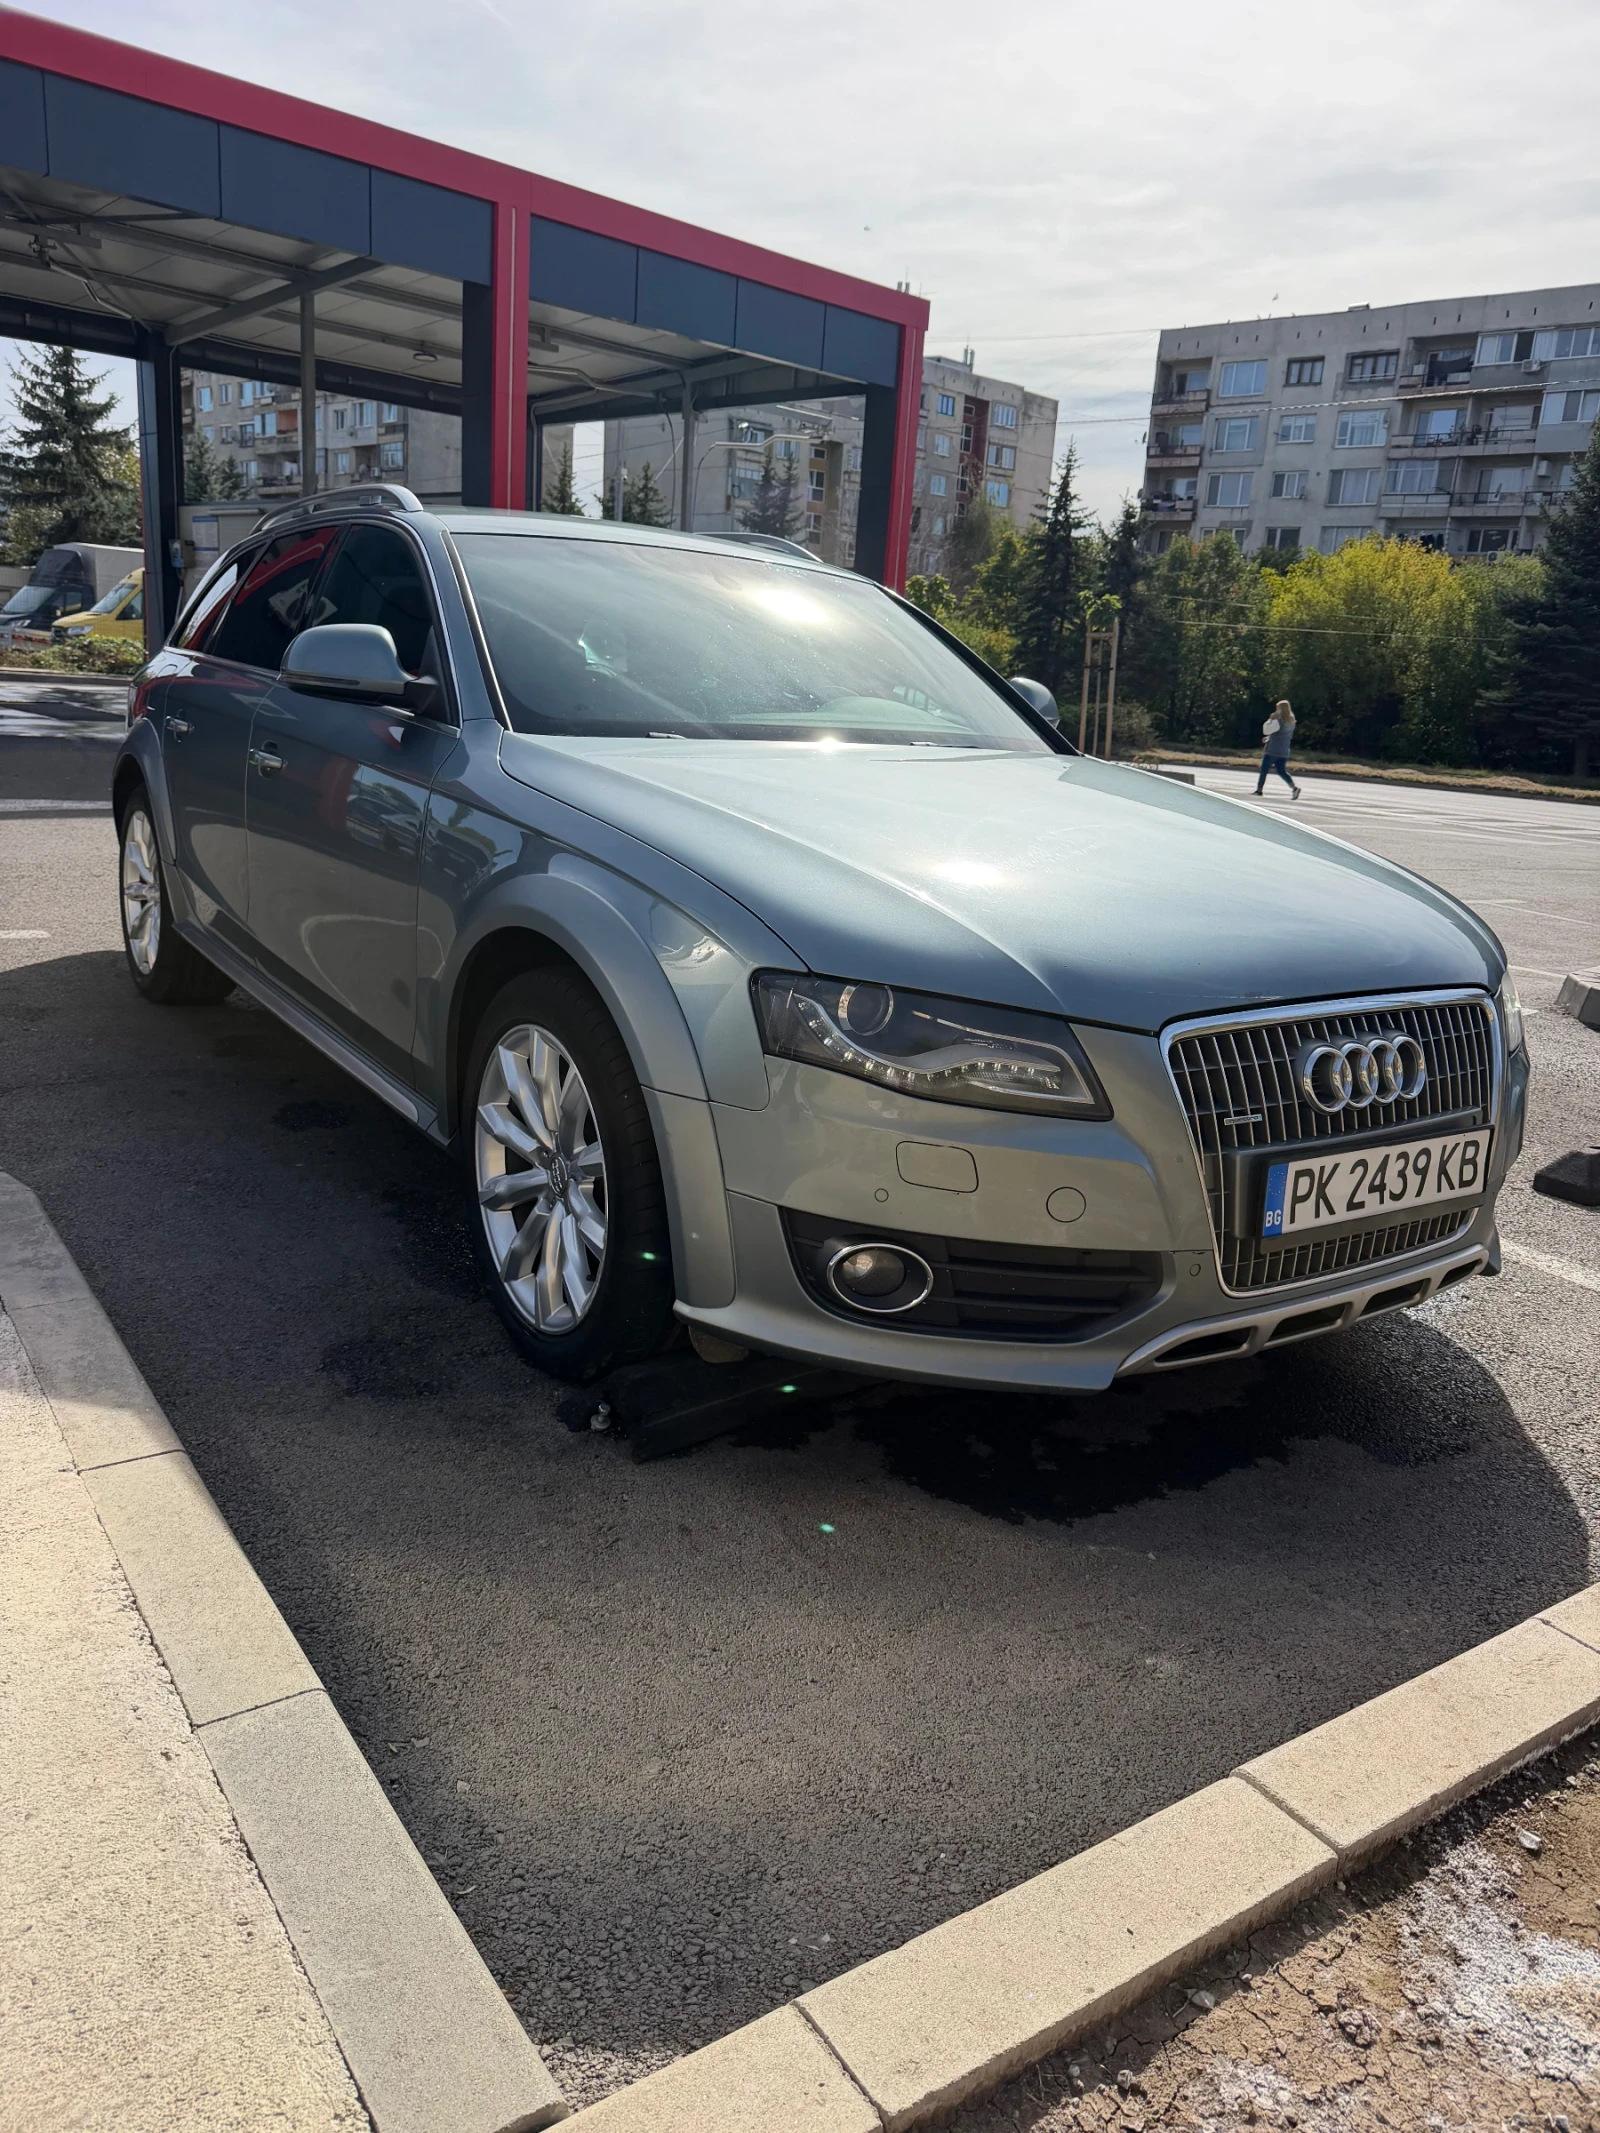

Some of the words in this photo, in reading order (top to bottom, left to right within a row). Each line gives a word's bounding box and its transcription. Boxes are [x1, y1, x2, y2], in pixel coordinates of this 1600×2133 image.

[1289, 1163, 1340, 1224] PK
[1346, 1148, 1431, 1212] 2439
[1437, 1139, 1480, 1193] KB
[1265, 1210, 1281, 1227] BG
